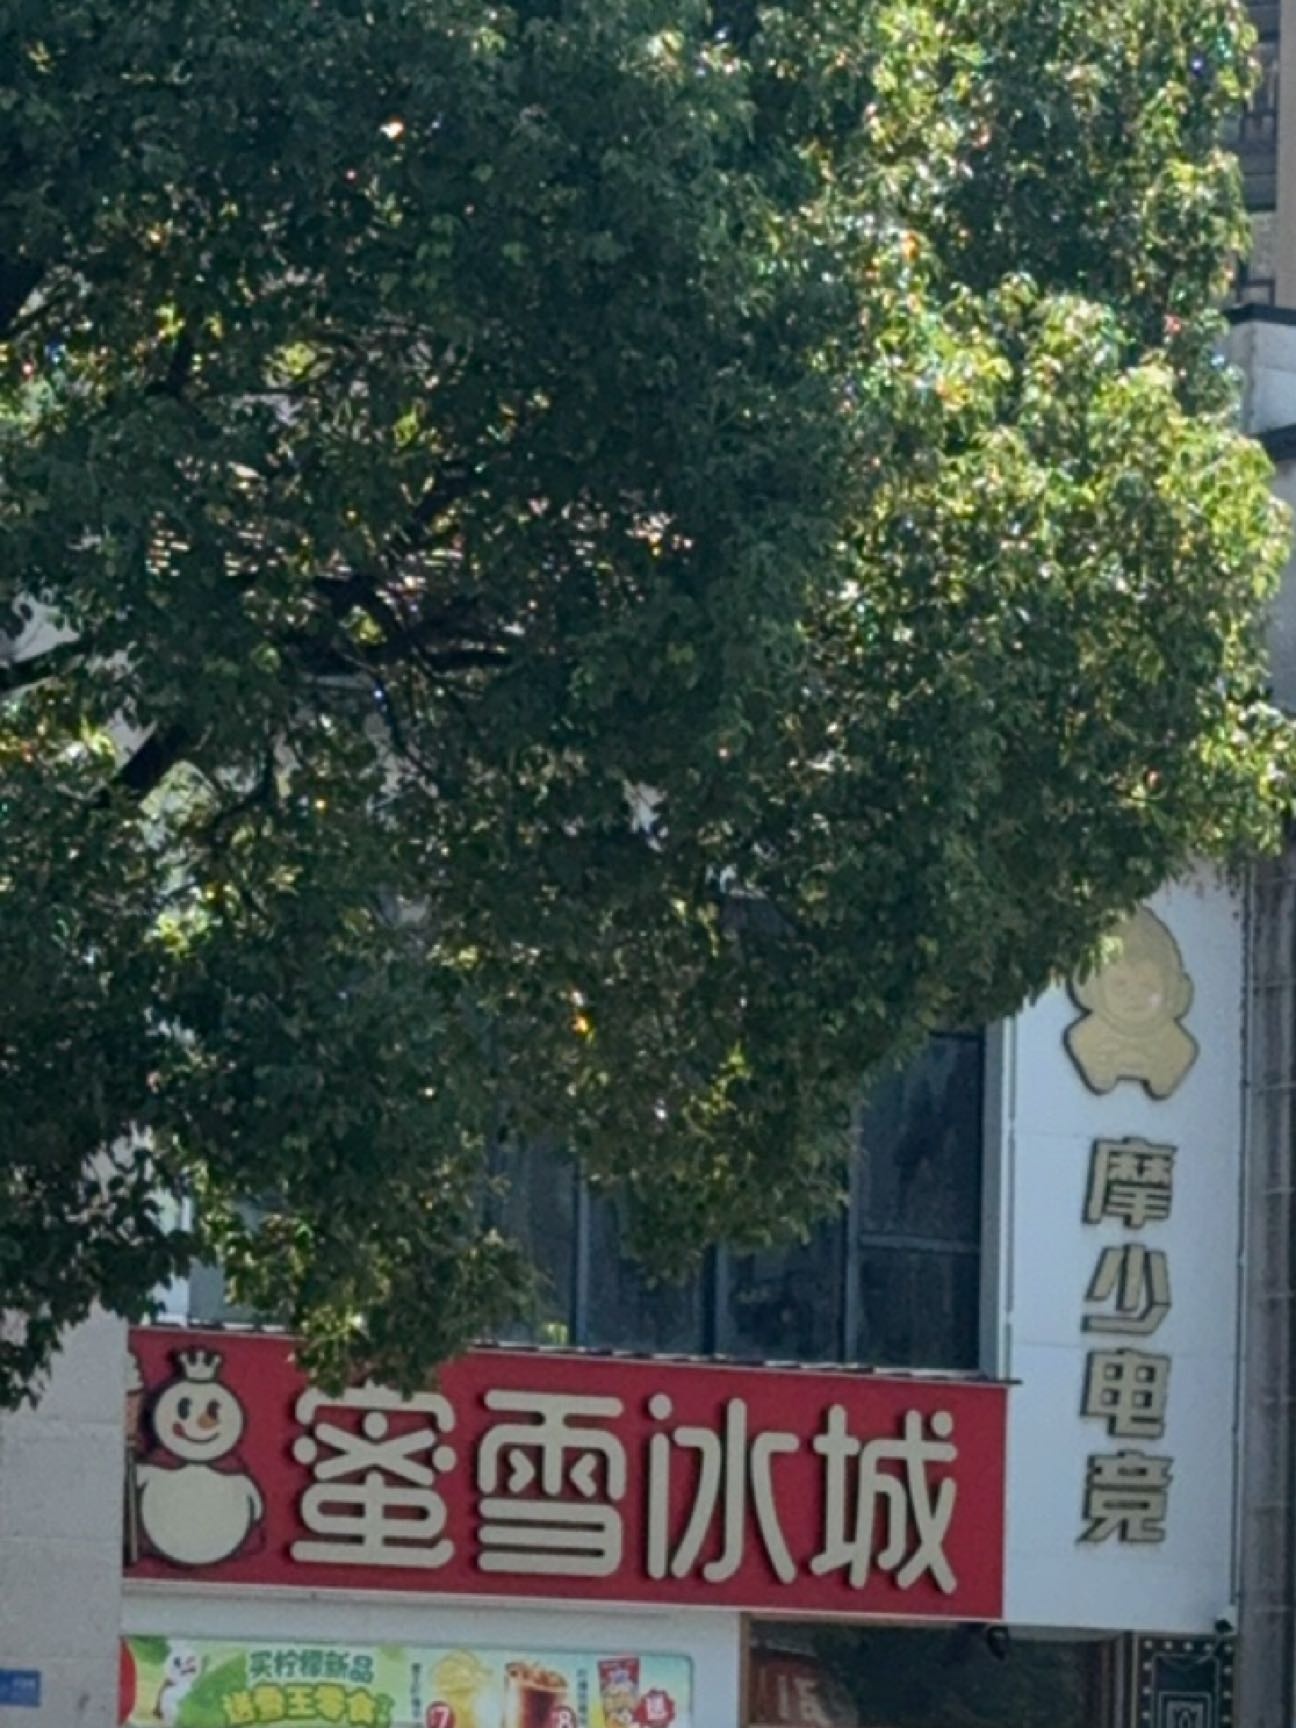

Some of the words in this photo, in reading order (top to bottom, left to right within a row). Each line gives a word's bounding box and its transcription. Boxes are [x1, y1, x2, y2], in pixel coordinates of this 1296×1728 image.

[290, 1385, 958, 1594] 蜜雪冰城
[1076, 1136, 1178, 1543] 摩少电竞
